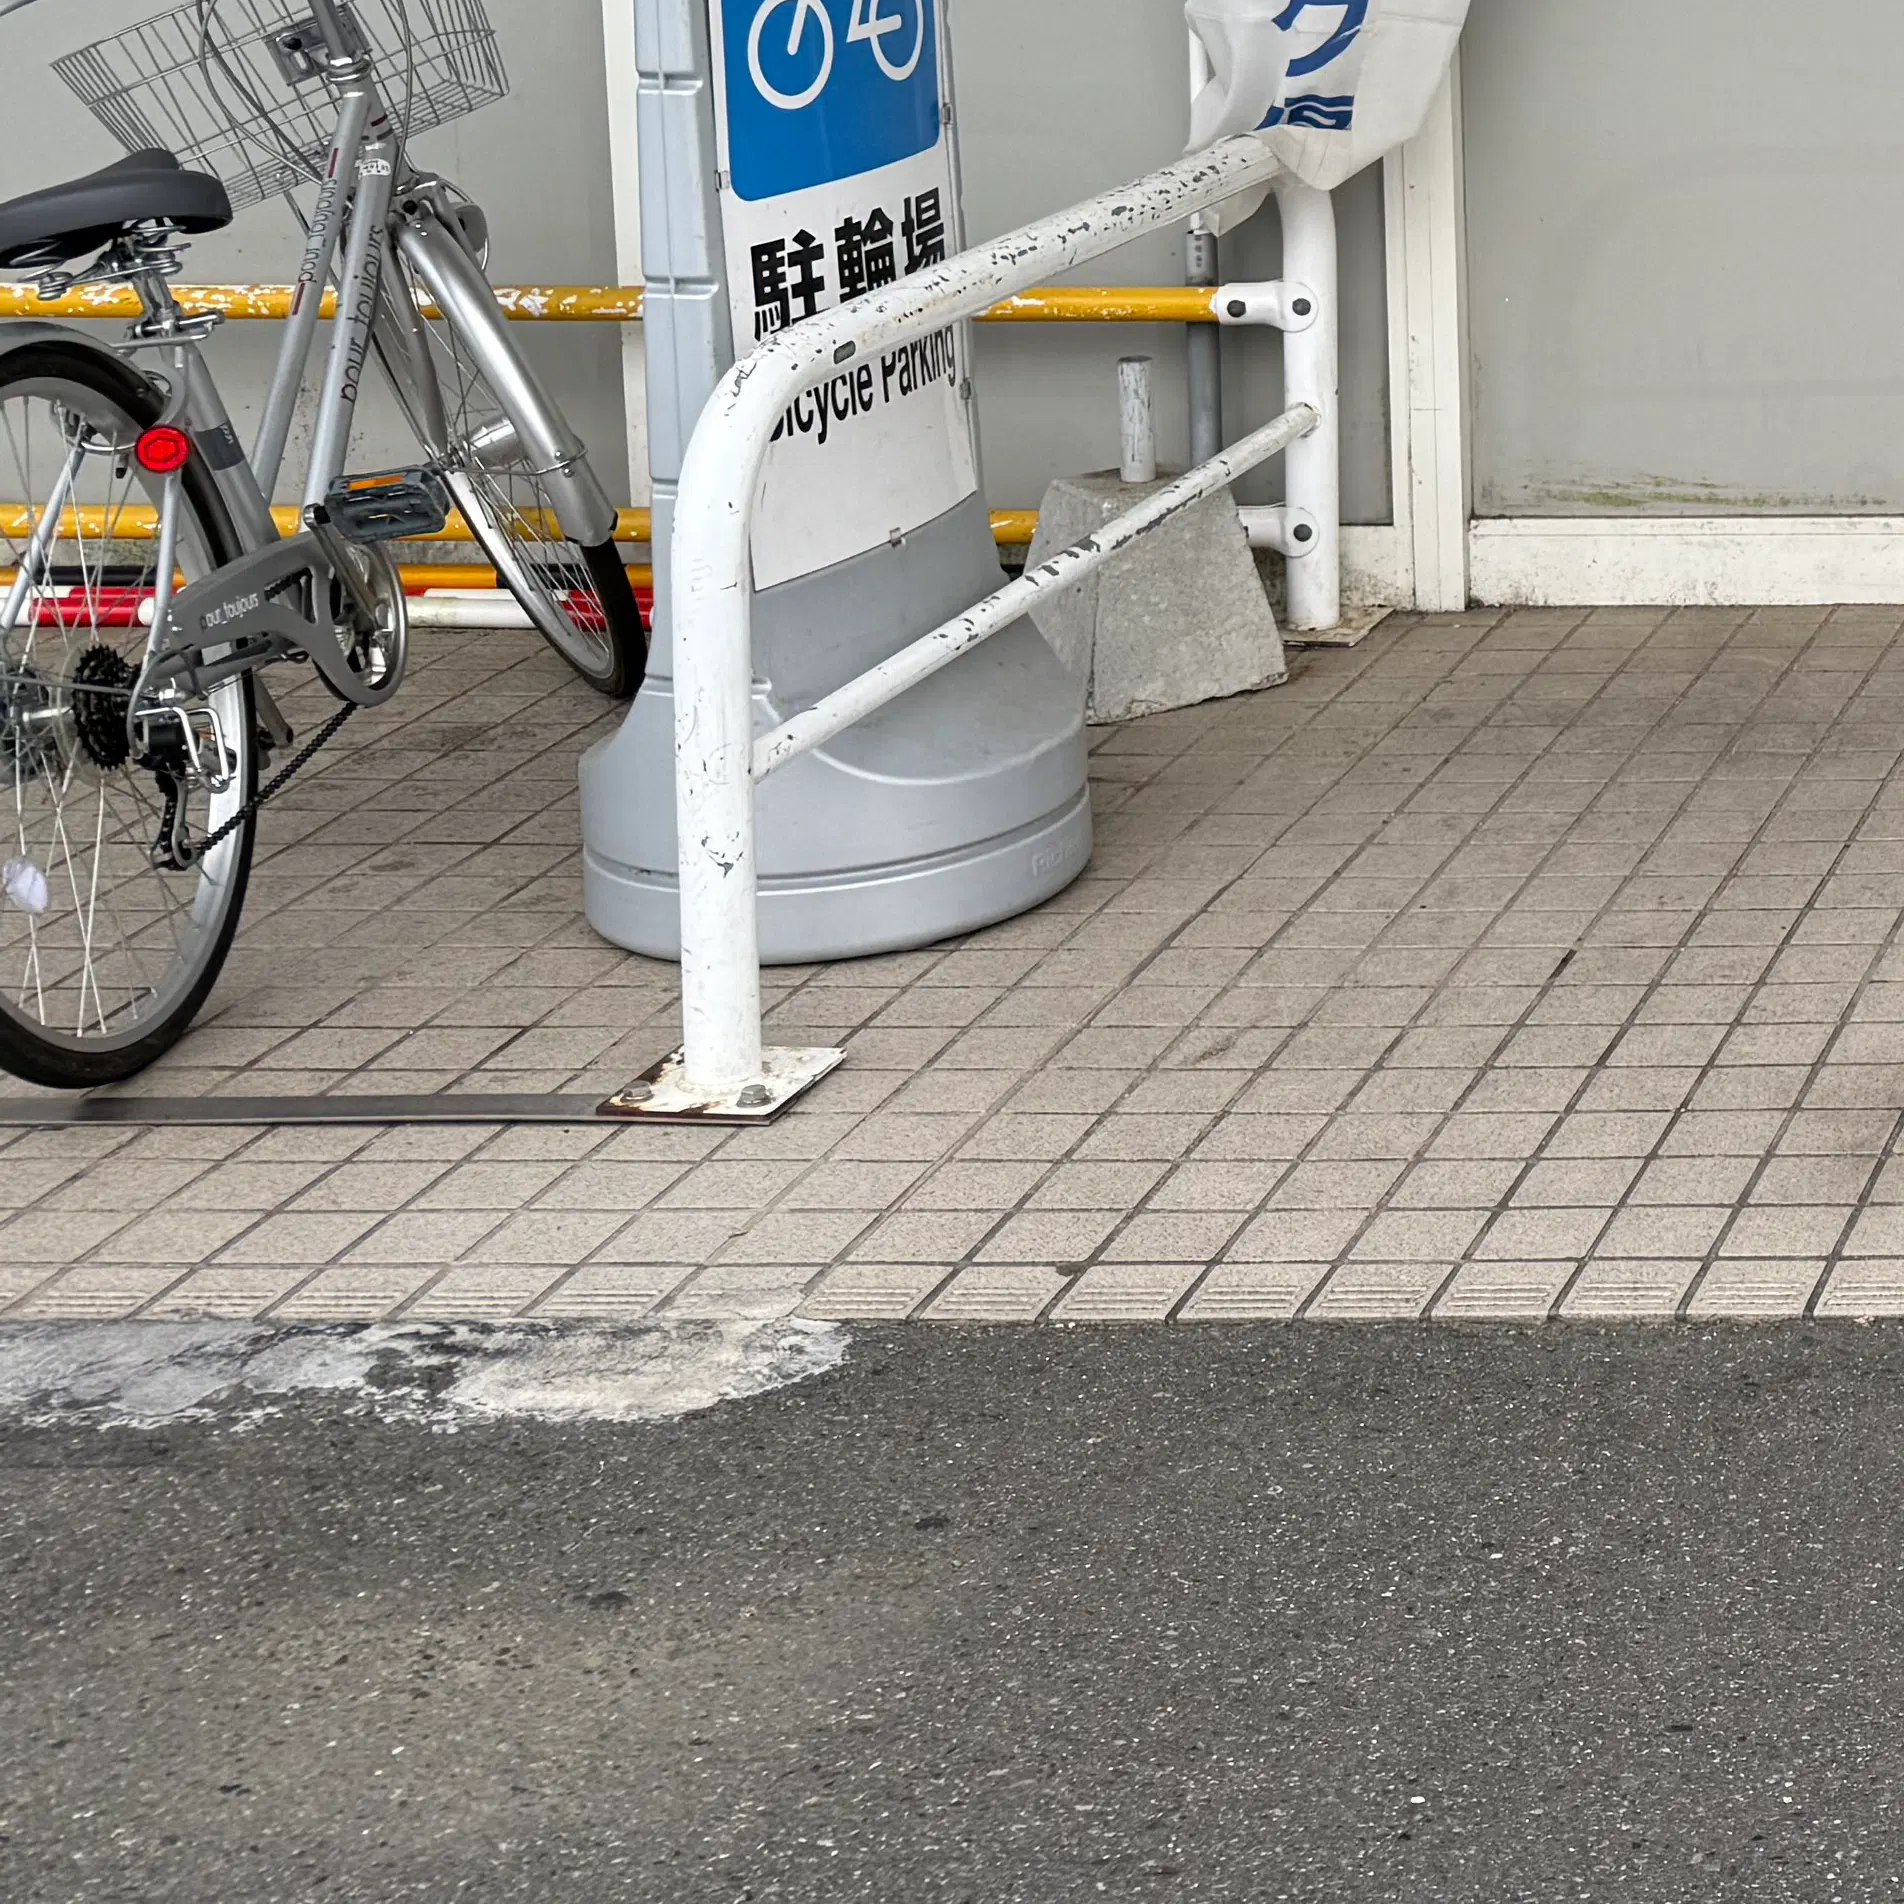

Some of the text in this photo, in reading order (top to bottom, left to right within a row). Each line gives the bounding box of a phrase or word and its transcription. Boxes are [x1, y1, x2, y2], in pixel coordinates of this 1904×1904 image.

[751, 186, 947, 342] 駐輪場
[769, 325, 957, 445] icycle Parking
